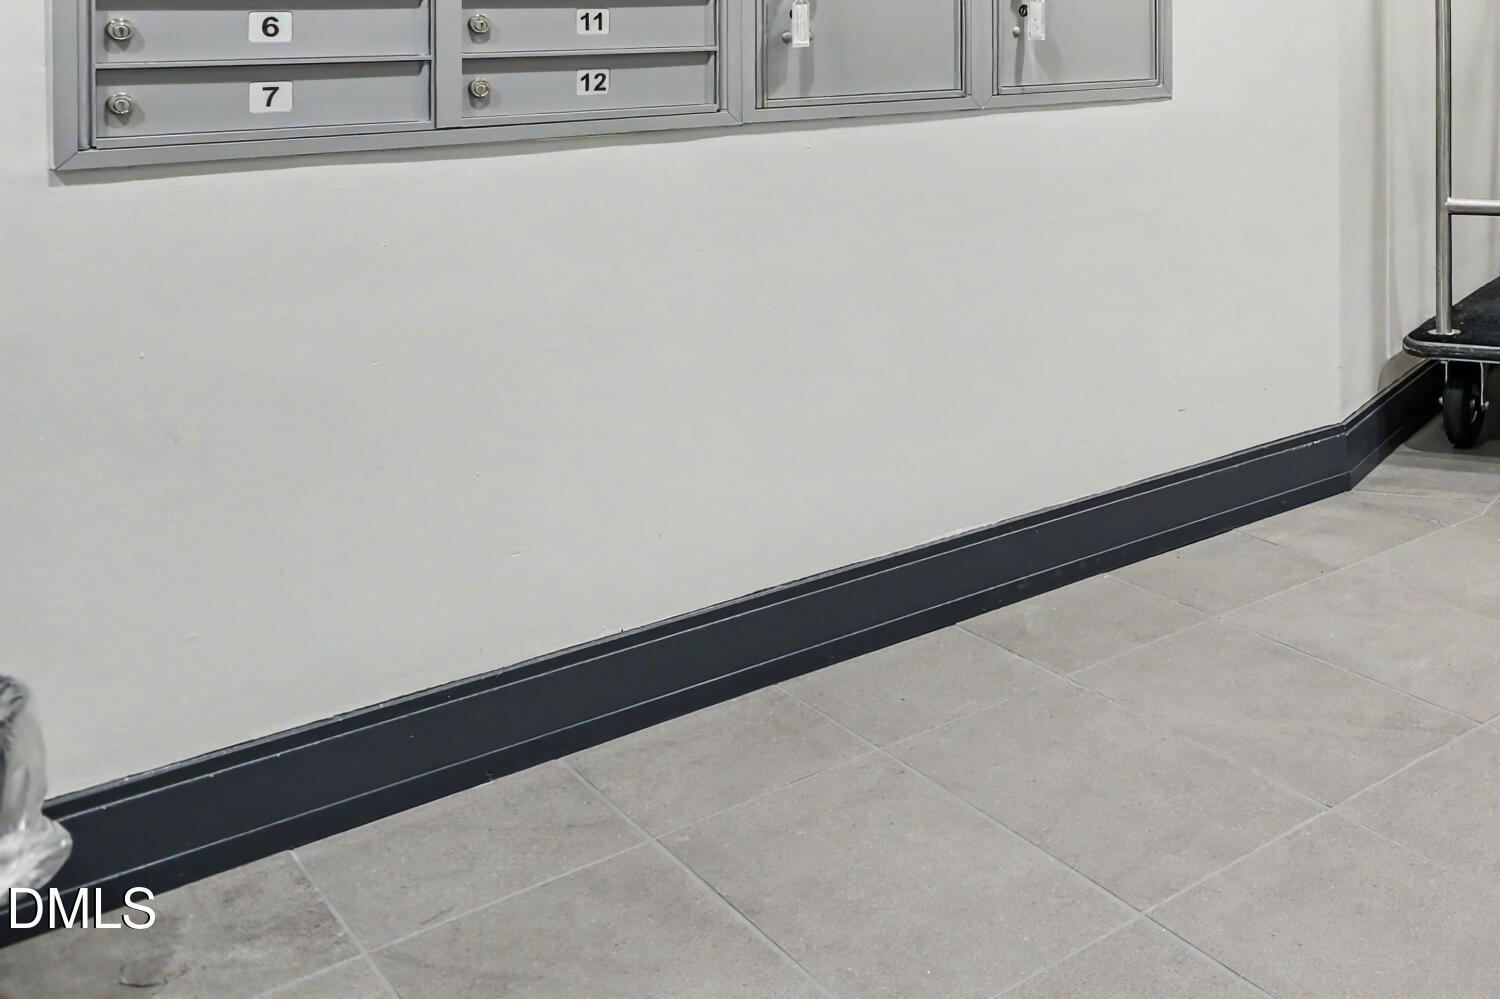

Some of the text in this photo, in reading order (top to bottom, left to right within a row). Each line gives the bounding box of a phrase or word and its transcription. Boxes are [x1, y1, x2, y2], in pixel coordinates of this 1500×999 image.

[261, 16, 280, 38] 6
[580, 12, 603, 31] 11
[580, 72, 607, 92] 12
[262, 86, 280, 107] 7
